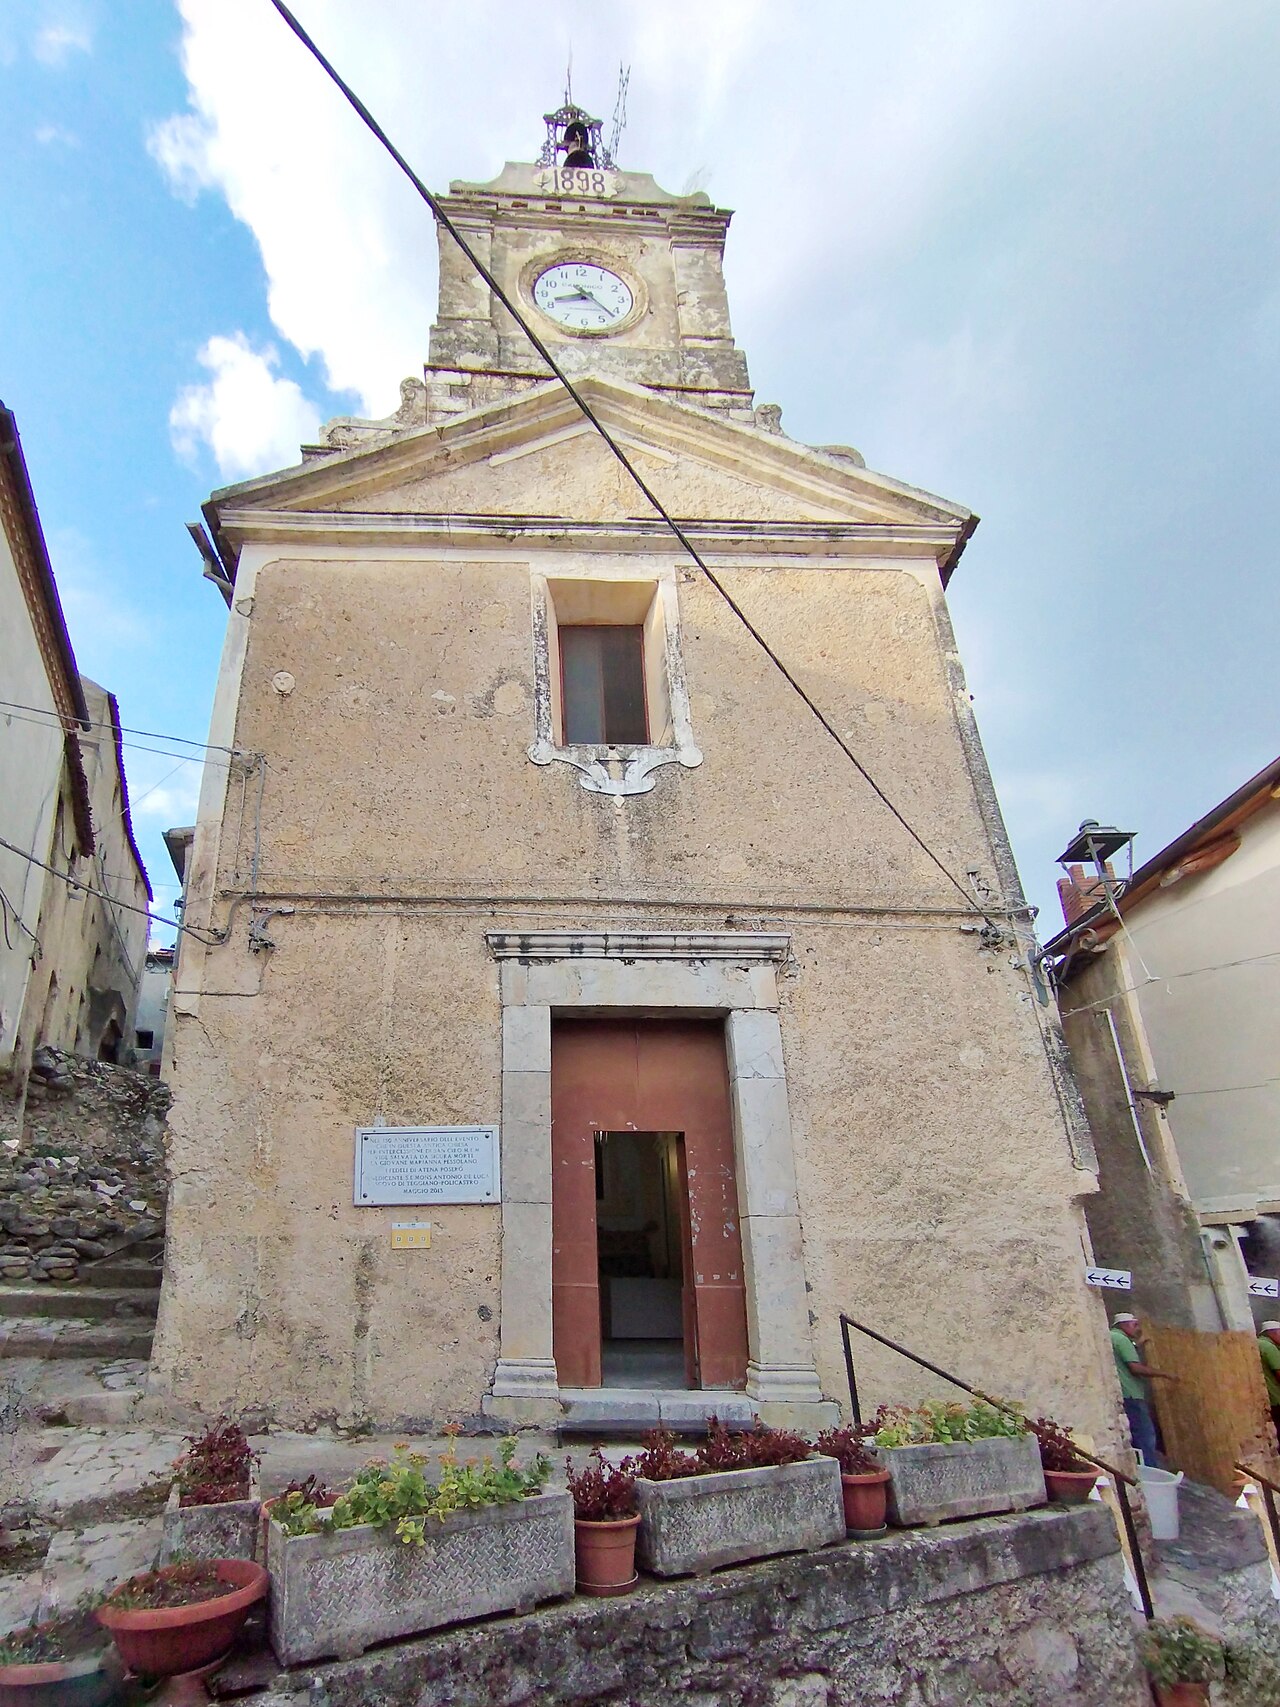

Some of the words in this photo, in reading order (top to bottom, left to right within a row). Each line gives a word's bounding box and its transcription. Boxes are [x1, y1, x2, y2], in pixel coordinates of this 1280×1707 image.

[553, 168, 606, 194] 1898
[560, 271, 568, 280] 11
[576, 268, 588, 277] 12
[545, 280, 557, 289] 10
[610, 284, 619, 293] 2
[540, 289, 549, 298] 9
[617, 296, 625, 304] 3
[547, 301, 555, 309] 8
[612, 306, 620, 315] 4
[563, 312, 570, 321] 7
[598, 315, 606, 323] 5
[580, 318, 589, 326] 6
